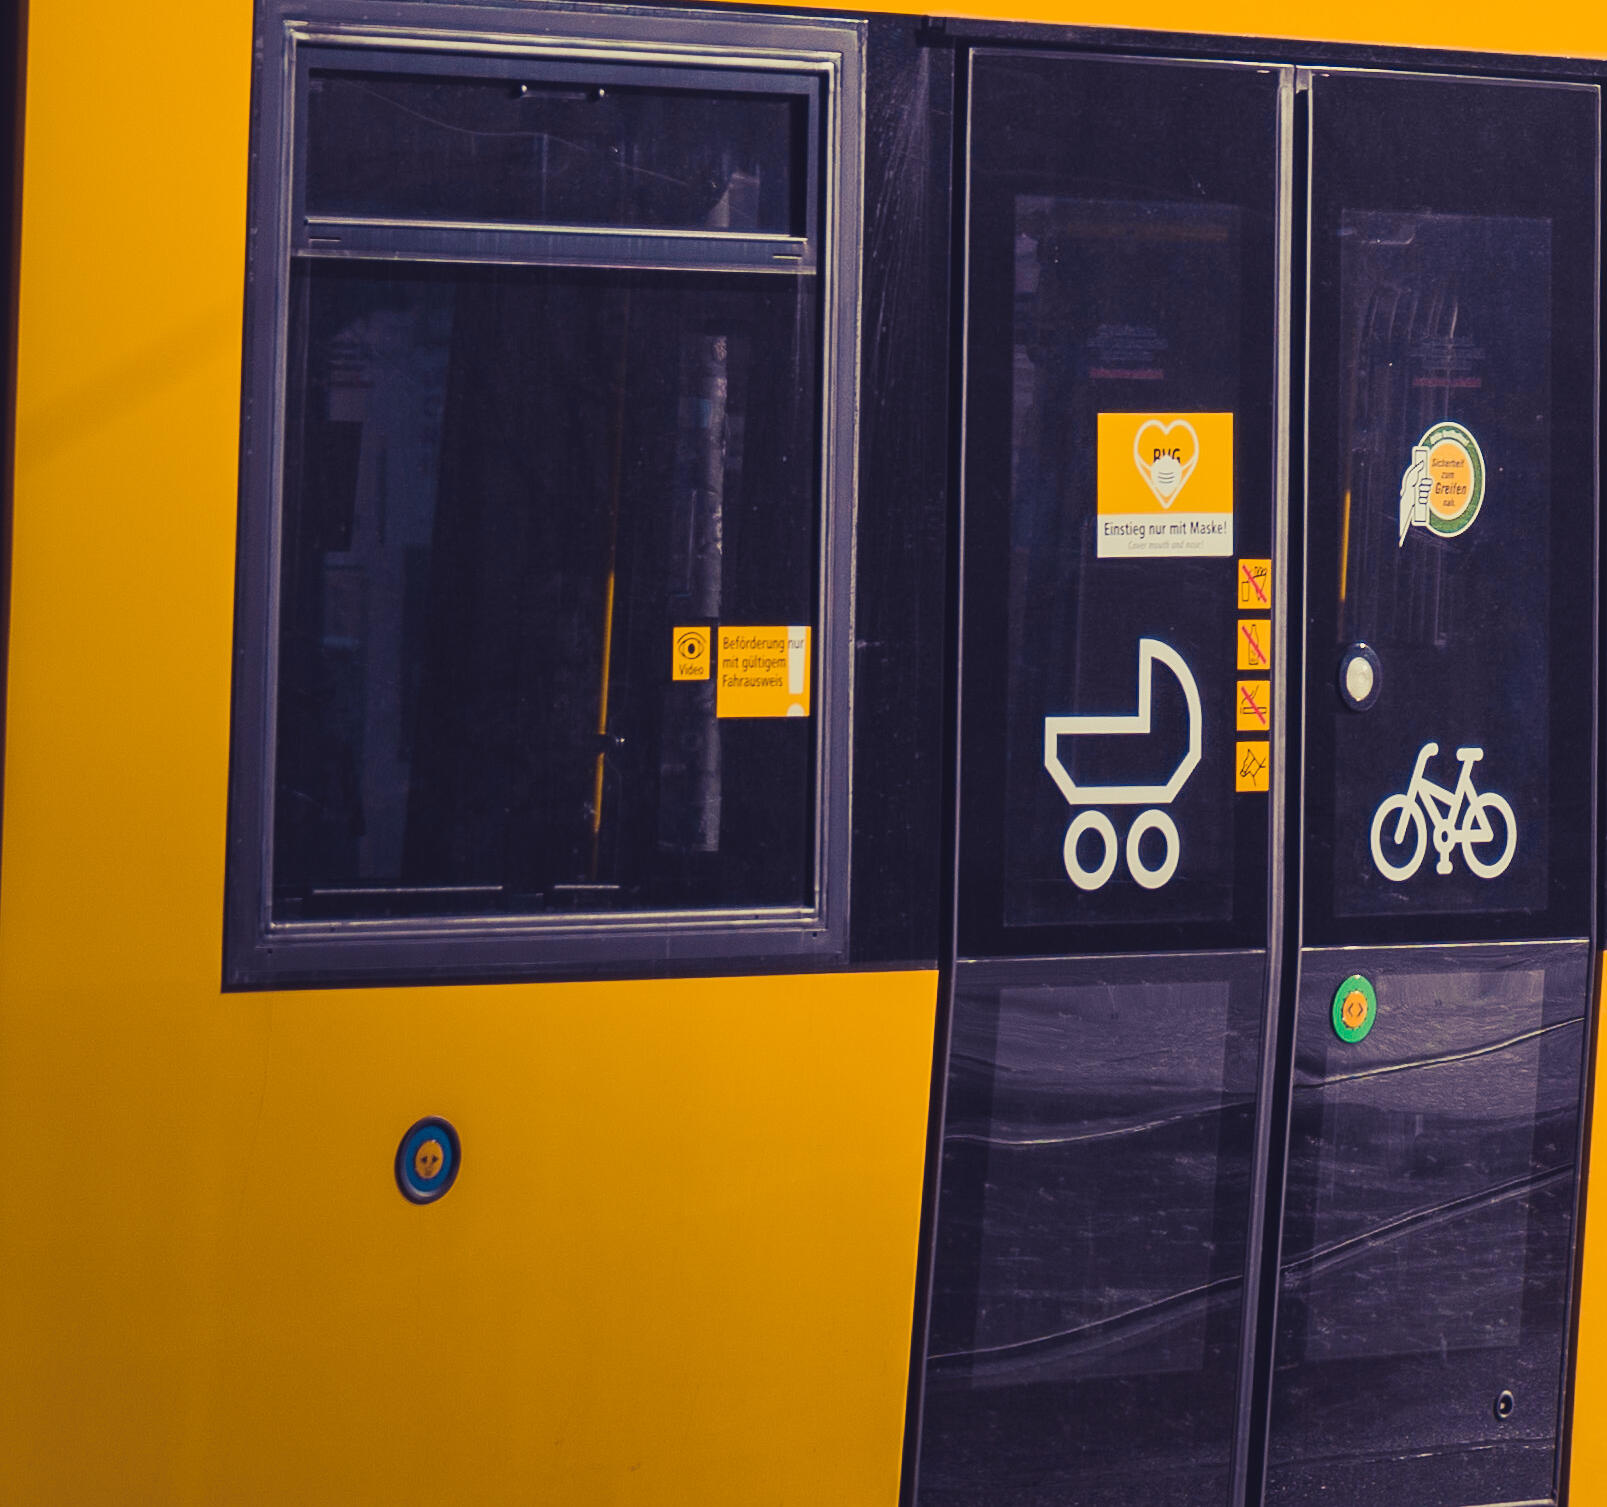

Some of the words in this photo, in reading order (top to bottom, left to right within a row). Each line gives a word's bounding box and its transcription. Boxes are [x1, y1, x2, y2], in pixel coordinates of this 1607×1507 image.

[1435, 482, 1467, 495] Greifen
[1104, 521, 1146, 539] Einstieg
[1149, 524, 1166, 535] nur
[1169, 520, 1187, 535] mit
[1190, 519, 1227, 535] Maske!
[722, 636, 785, 653] Beförderung
[787, 639, 804, 649] nur
[679, 663, 704, 675] Video
[722, 656, 739, 668] mit
[741, 656, 786, 672] gültigem
[722, 674, 783, 687] Fahrausweis
